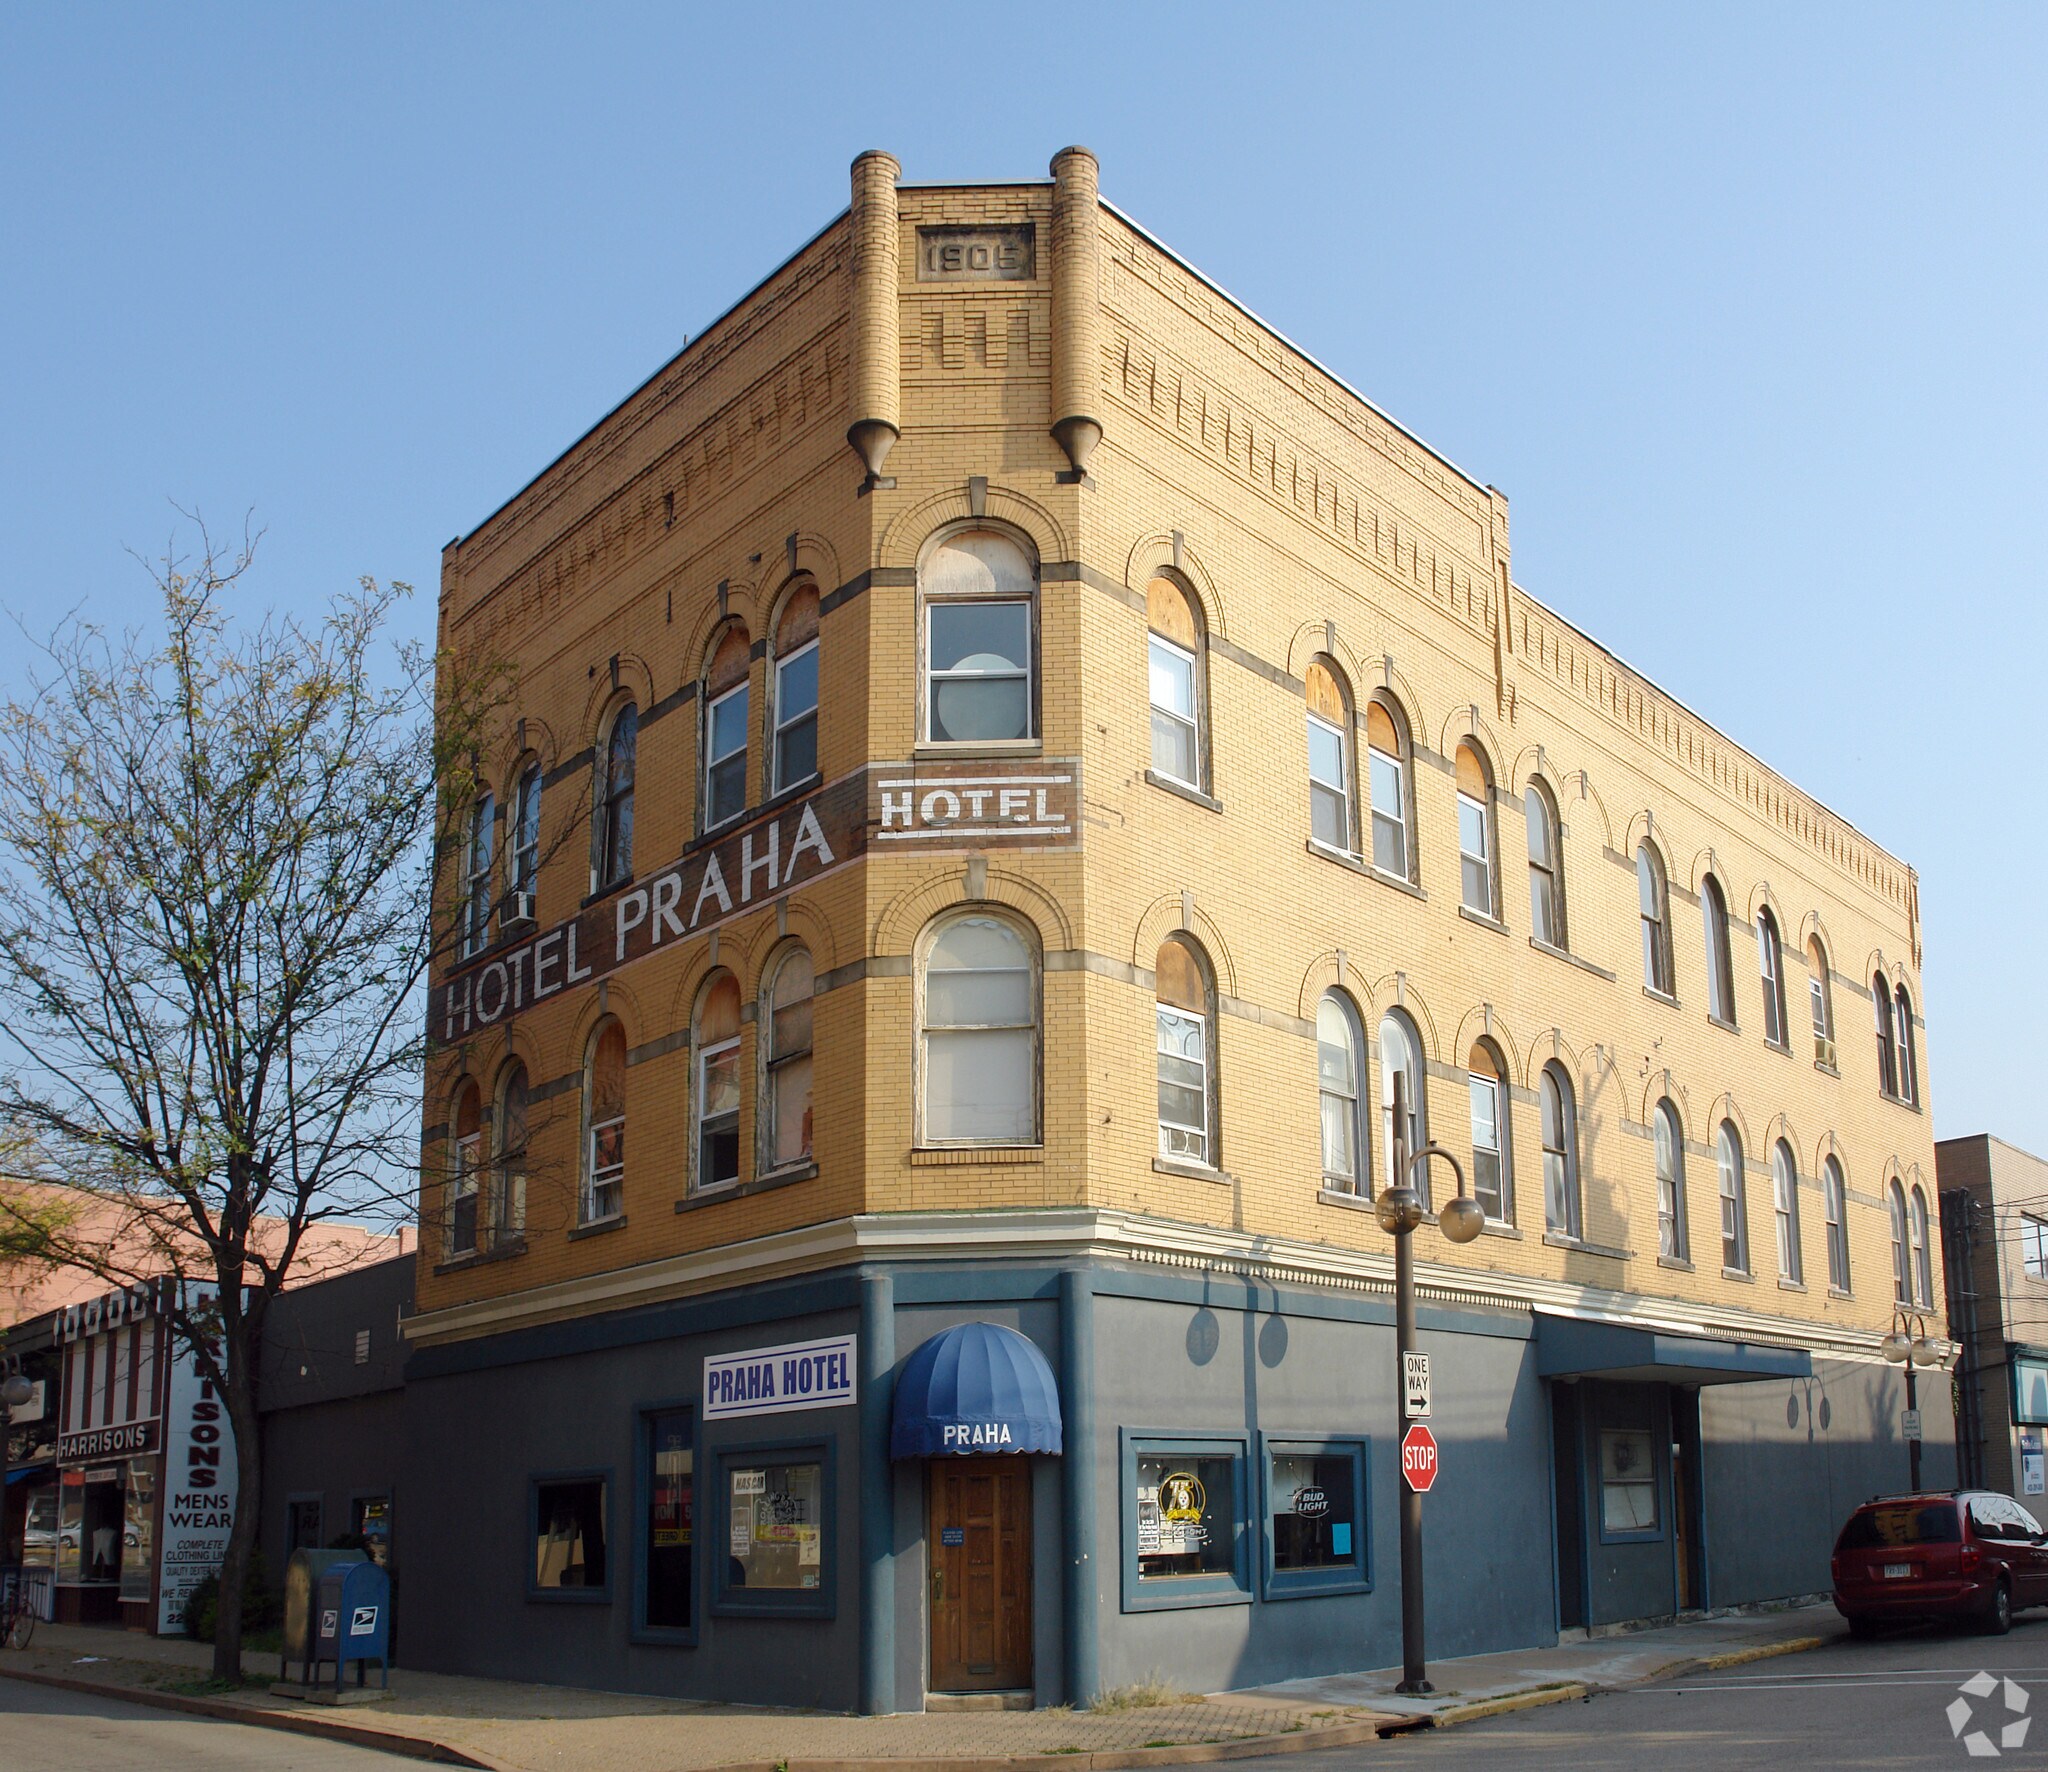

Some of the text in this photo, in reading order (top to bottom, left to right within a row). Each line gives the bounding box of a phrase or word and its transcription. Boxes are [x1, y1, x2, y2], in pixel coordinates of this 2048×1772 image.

[881, 788, 1065, 827] HOTEL
[445, 800, 836, 1041] HOTEL PRAHA
[1407, 1357, 1428, 1373] ONE
[708, 1351, 851, 1405] PRAHA HOTEL
[1408, 1375, 1429, 1391] WAY
[60, 1424, 146, 1457] HARRISONS
[943, 1423, 1013, 1446] PRAHA
[1404, 1444, 1436, 1472] STOP
[174, 1493, 229, 1509] MENS
[1302, 1492, 1325, 1502] BUD
[1297, 1501, 1329, 1512] LIGHT
[169, 1512, 232, 1529] WEAR
[177, 1540, 225, 1550] COMPLETE
[166, 1550, 227, 1561] CLOTHING LIN
[161, 1588, 175, 1599] WE
